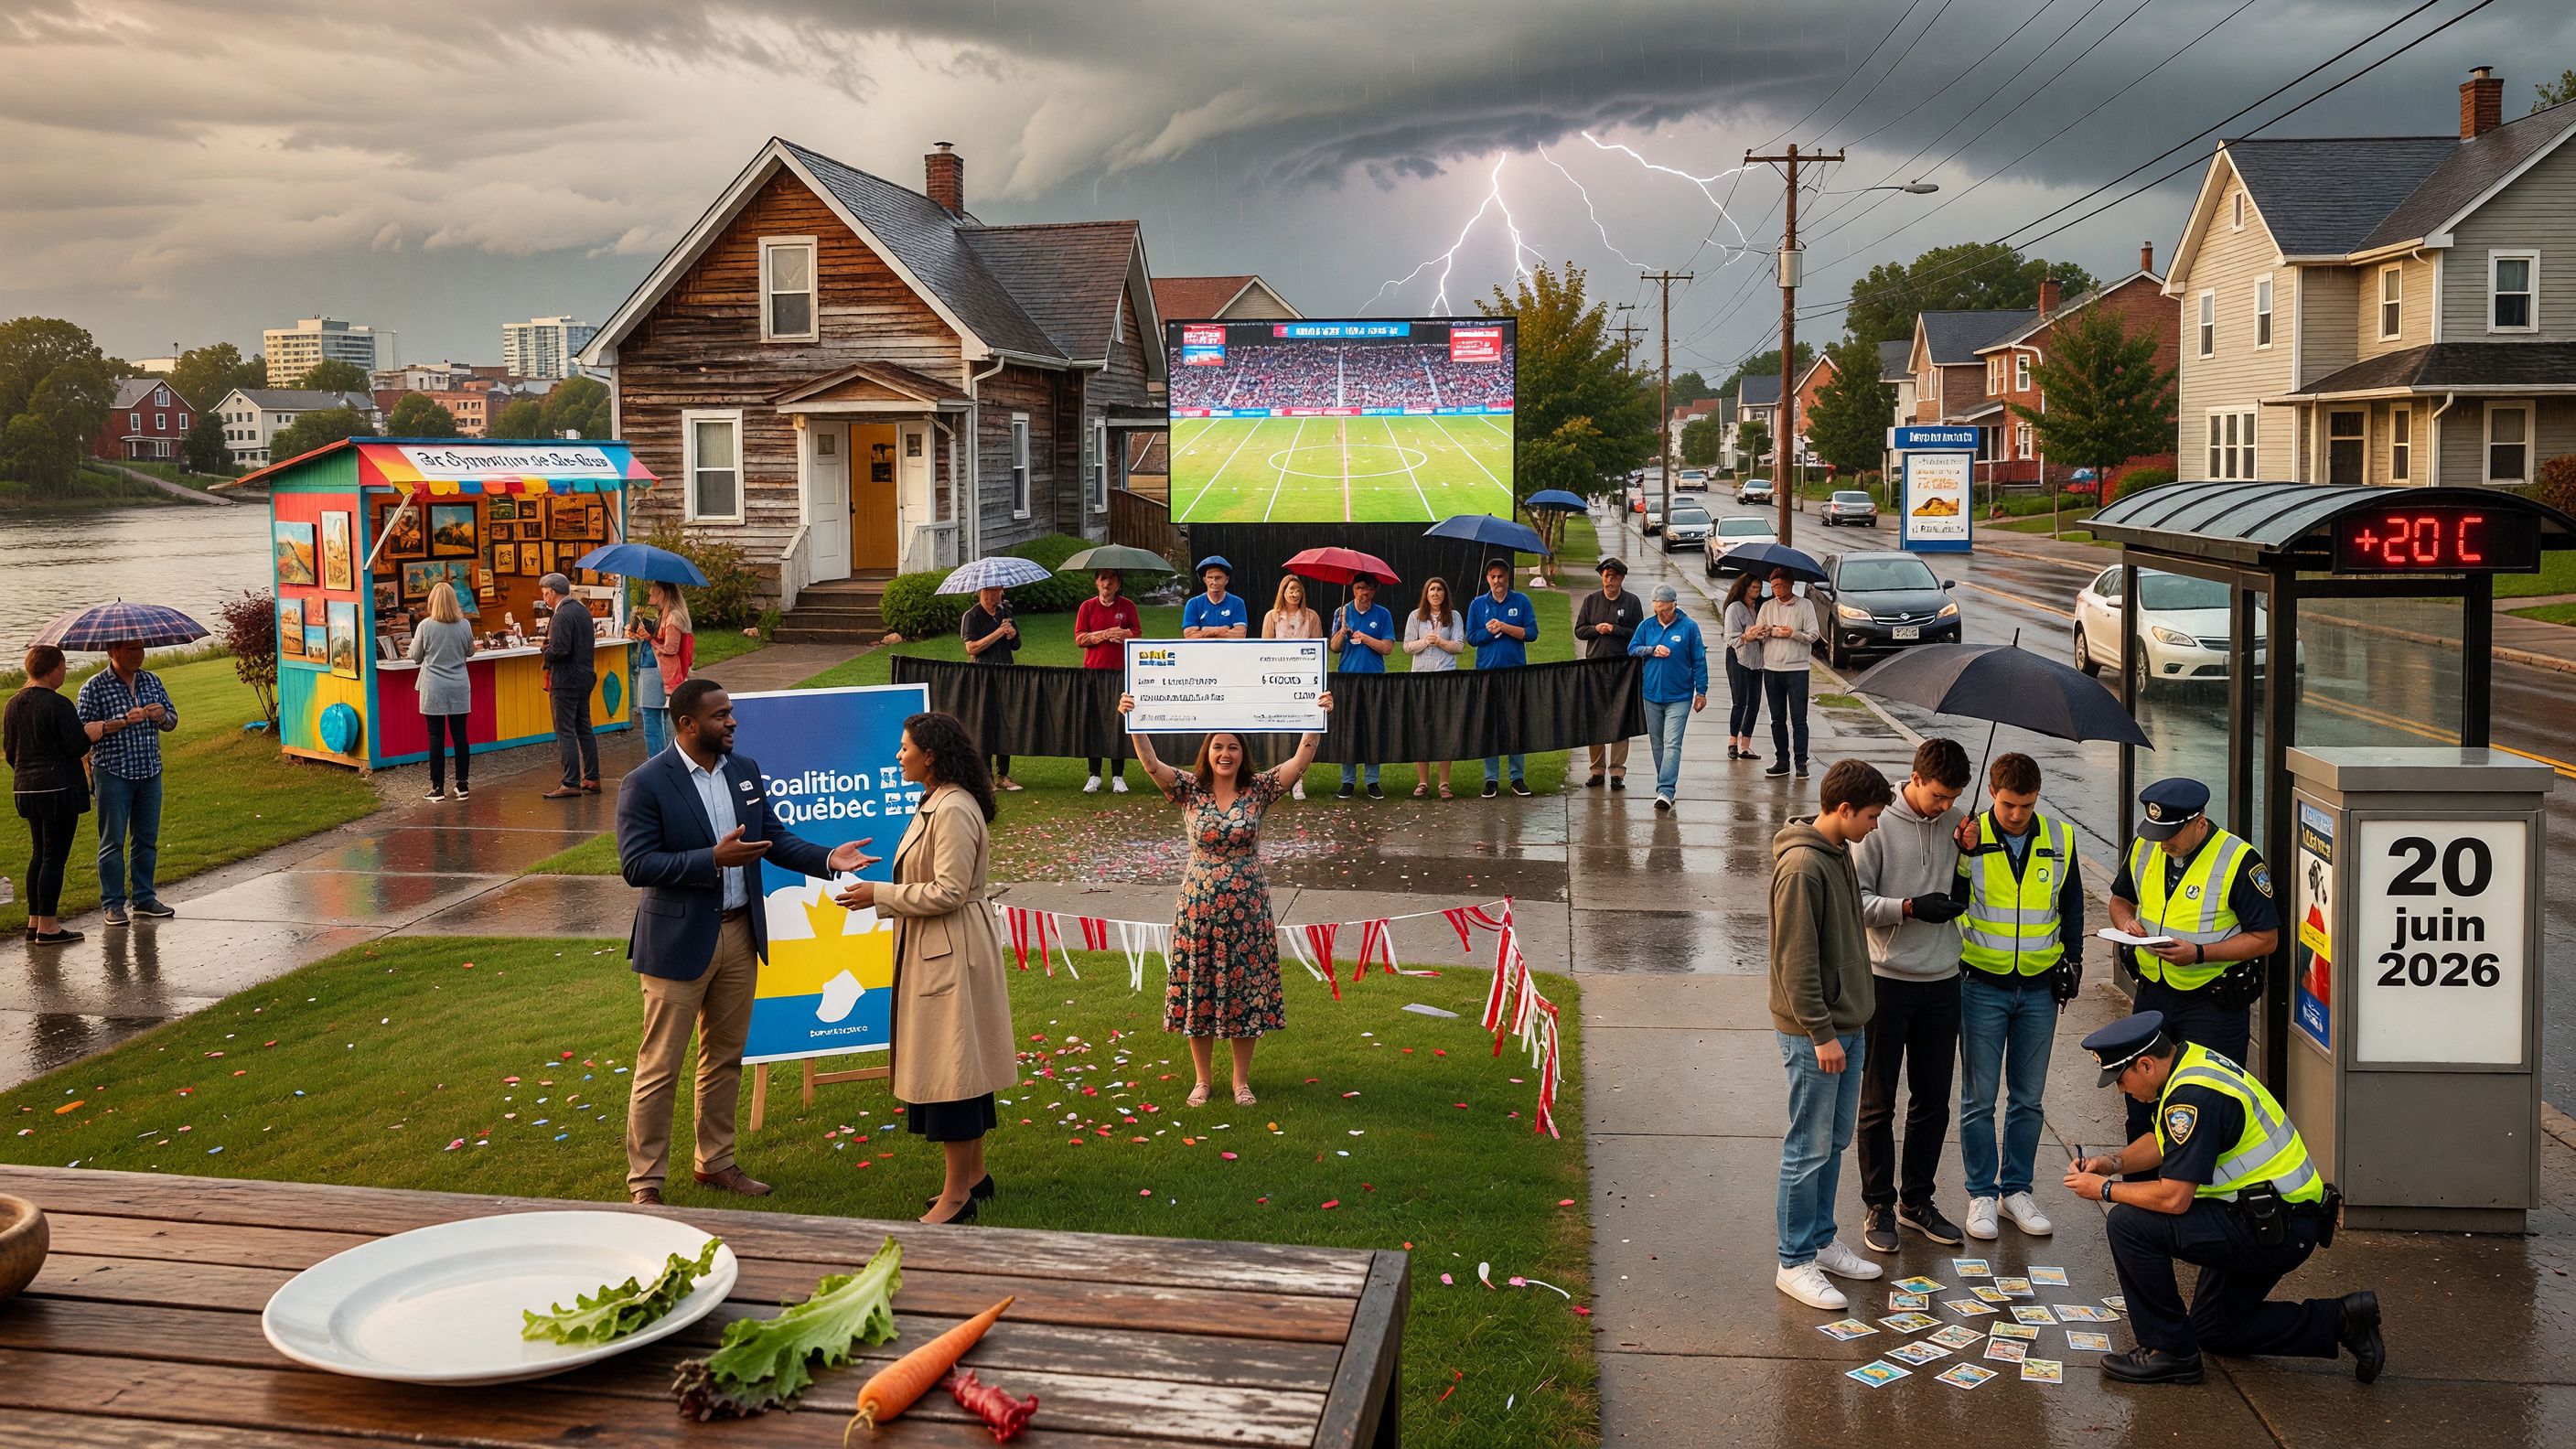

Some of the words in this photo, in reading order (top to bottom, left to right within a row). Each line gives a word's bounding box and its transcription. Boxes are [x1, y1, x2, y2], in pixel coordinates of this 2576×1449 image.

[2355, 517, 2441, 564] +20
[2457, 516, 2483, 563] C
[773, 796, 876, 826] Québec
[2386, 836, 2493, 897] 20
[2390, 907, 2485, 950] juin
[2377, 951, 2500, 987] 2026
